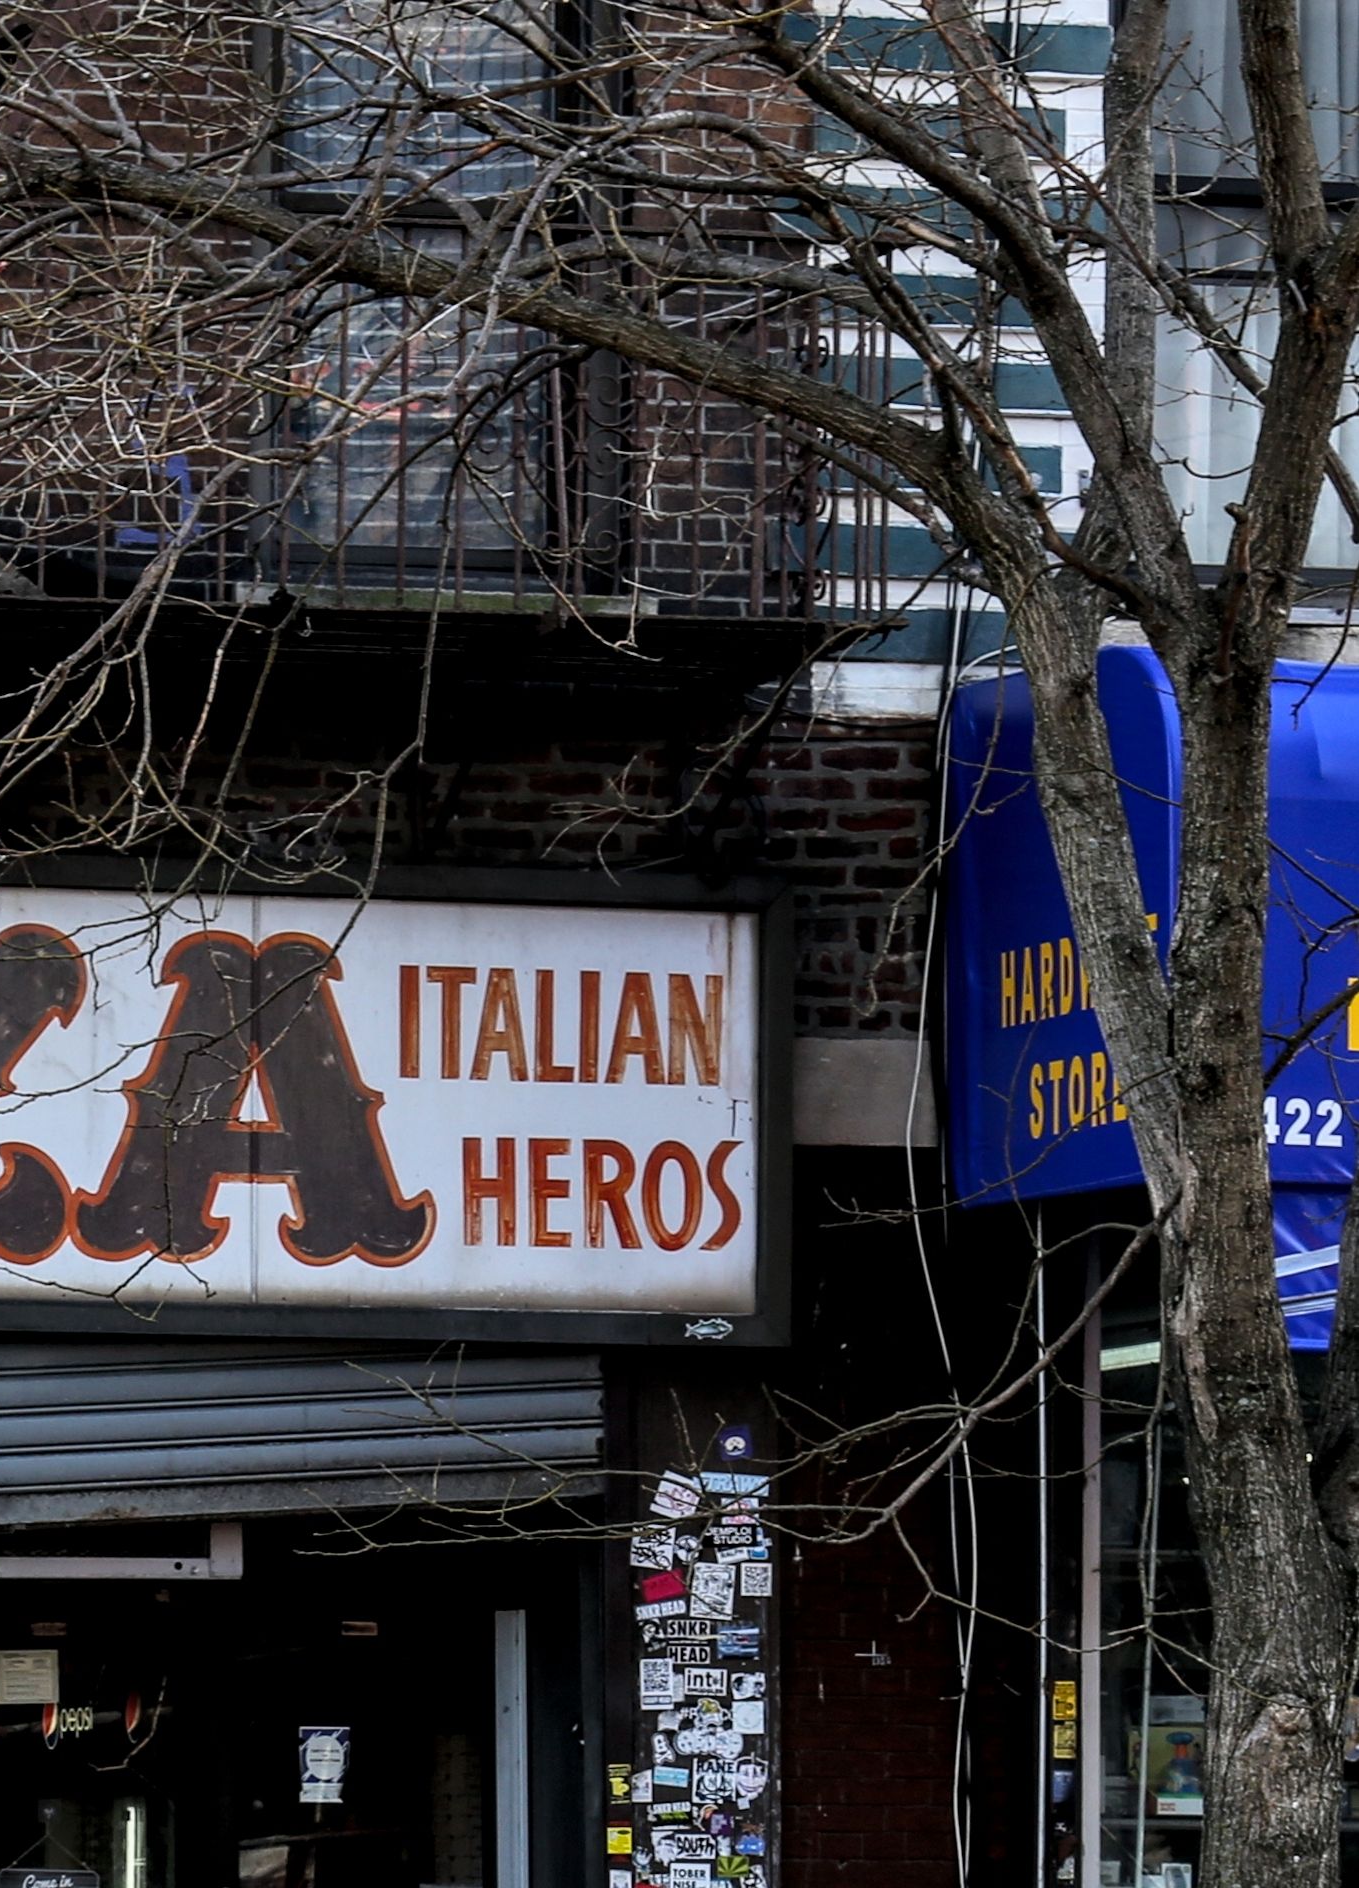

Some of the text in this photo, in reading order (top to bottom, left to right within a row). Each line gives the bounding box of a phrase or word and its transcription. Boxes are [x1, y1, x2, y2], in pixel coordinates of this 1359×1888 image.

[398, 964, 725, 1086] ITALIAN
[462, 1137, 745, 1252] HEROS
[668, 1621, 709, 1636] SNKR
[669, 1647, 709, 1662] HEAD
[59, 1707, 93, 1739] pepsi
[673, 1868, 706, 1878] TOBER
[23, 1874, 74, 1888] Come in
